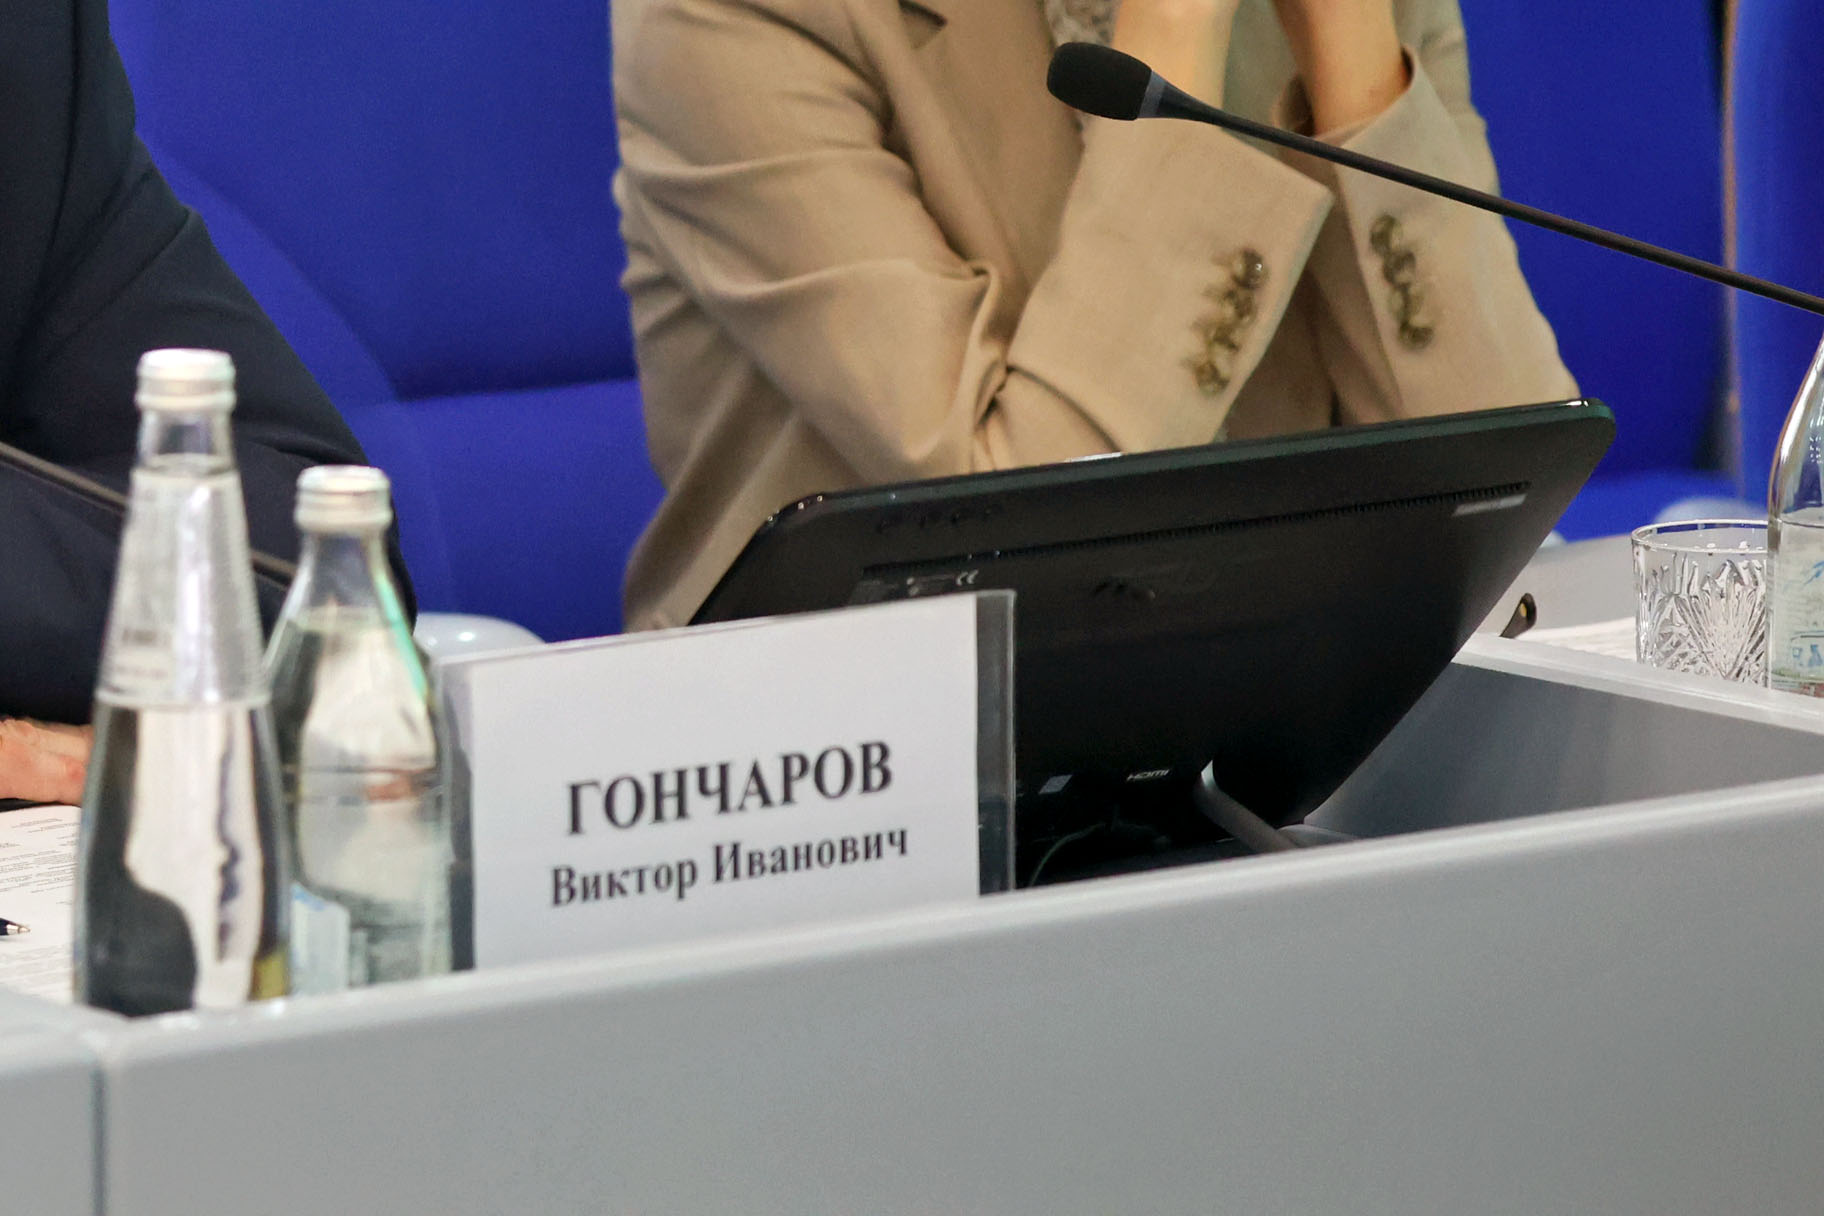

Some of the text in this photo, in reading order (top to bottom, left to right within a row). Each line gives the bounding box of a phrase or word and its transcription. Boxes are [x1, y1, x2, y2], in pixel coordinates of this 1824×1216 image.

[566, 740, 893, 837] ГОНЧАРОВ
[550, 828, 908, 908] Виктор Иванович
